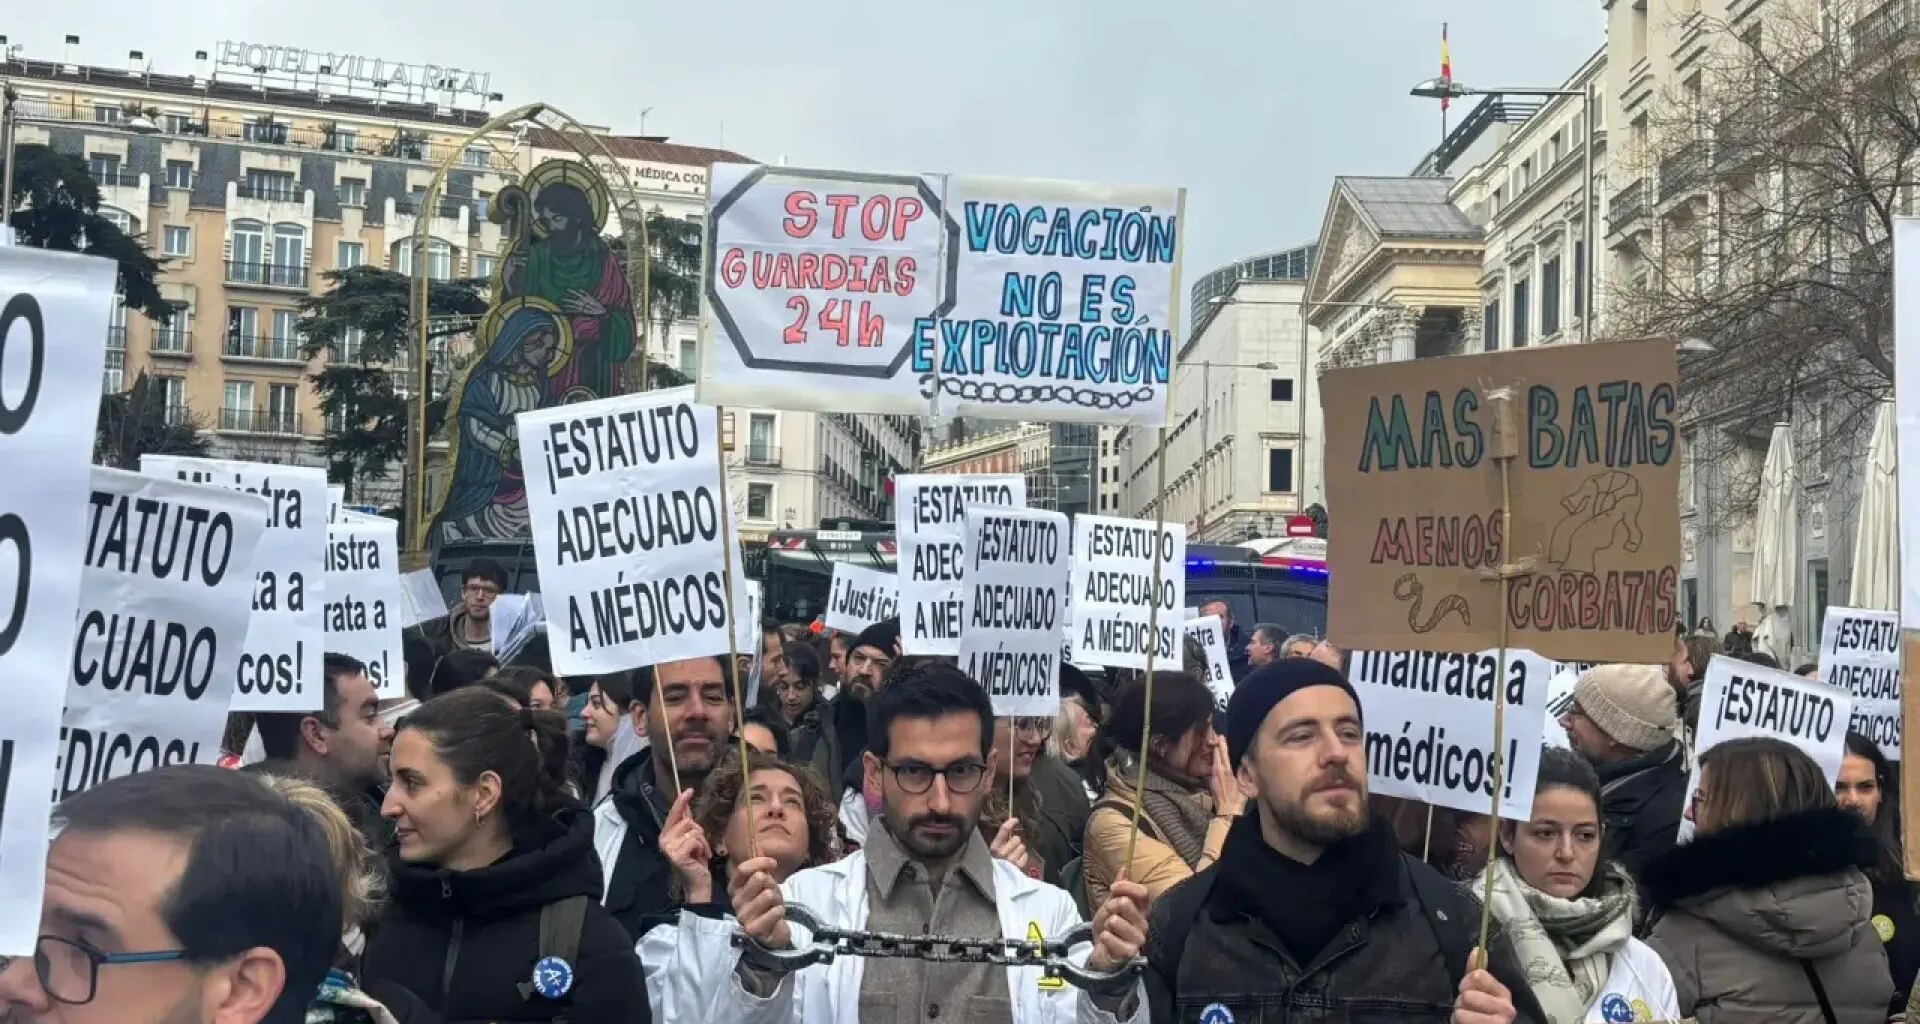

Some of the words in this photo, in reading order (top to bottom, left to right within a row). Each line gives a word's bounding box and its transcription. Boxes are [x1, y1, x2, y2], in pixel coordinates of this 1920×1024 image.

[222, 40, 312, 74] HOTEL
[327, 53, 408, 86] VILLA
[421, 64, 491, 95] REAL
[635, 166, 681, 183] MÉDICA
[783, 191, 923, 241] STOP
[965, 201, 1176, 264] VOCACIÓN
[721, 248, 916, 295] GUARDIAS
[1001, 271, 1061, 319] NO
[1081, 274, 1136, 324] ES
[783, 296, 884, 348] 24h
[912, 314, 1171, 384] EXPLOTACIÓN
[543, 403, 699, 495] ¡ESTATUTO
[1358, 387, 1483, 473] MAS
[1528, 380, 1676, 468] BATAS
[557, 485, 718, 566] ADECUADO
[974, 516, 1058, 571] ¡ESTATUTO
[1370, 509, 1504, 570] MENOS
[288, 571, 304, 612] a
[374, 599, 388, 630] a
[971, 584, 1056, 630] ADECUADO
[1507, 564, 1677, 636] CORBATAS
[568, 595, 592, 652] A
[914, 601, 928, 639] A
[1083, 617, 1095, 651] A
[1832, 617, 1900, 655] ¡ESTATU
[981, 641, 1051, 696] MÉDICOS!
[1360, 650, 1496, 701] maltrata
[1506, 659, 1526, 706] a
[1715, 675, 1834, 743] ¡ESTATUTO
[1365, 721, 1517, 799] médicos!
